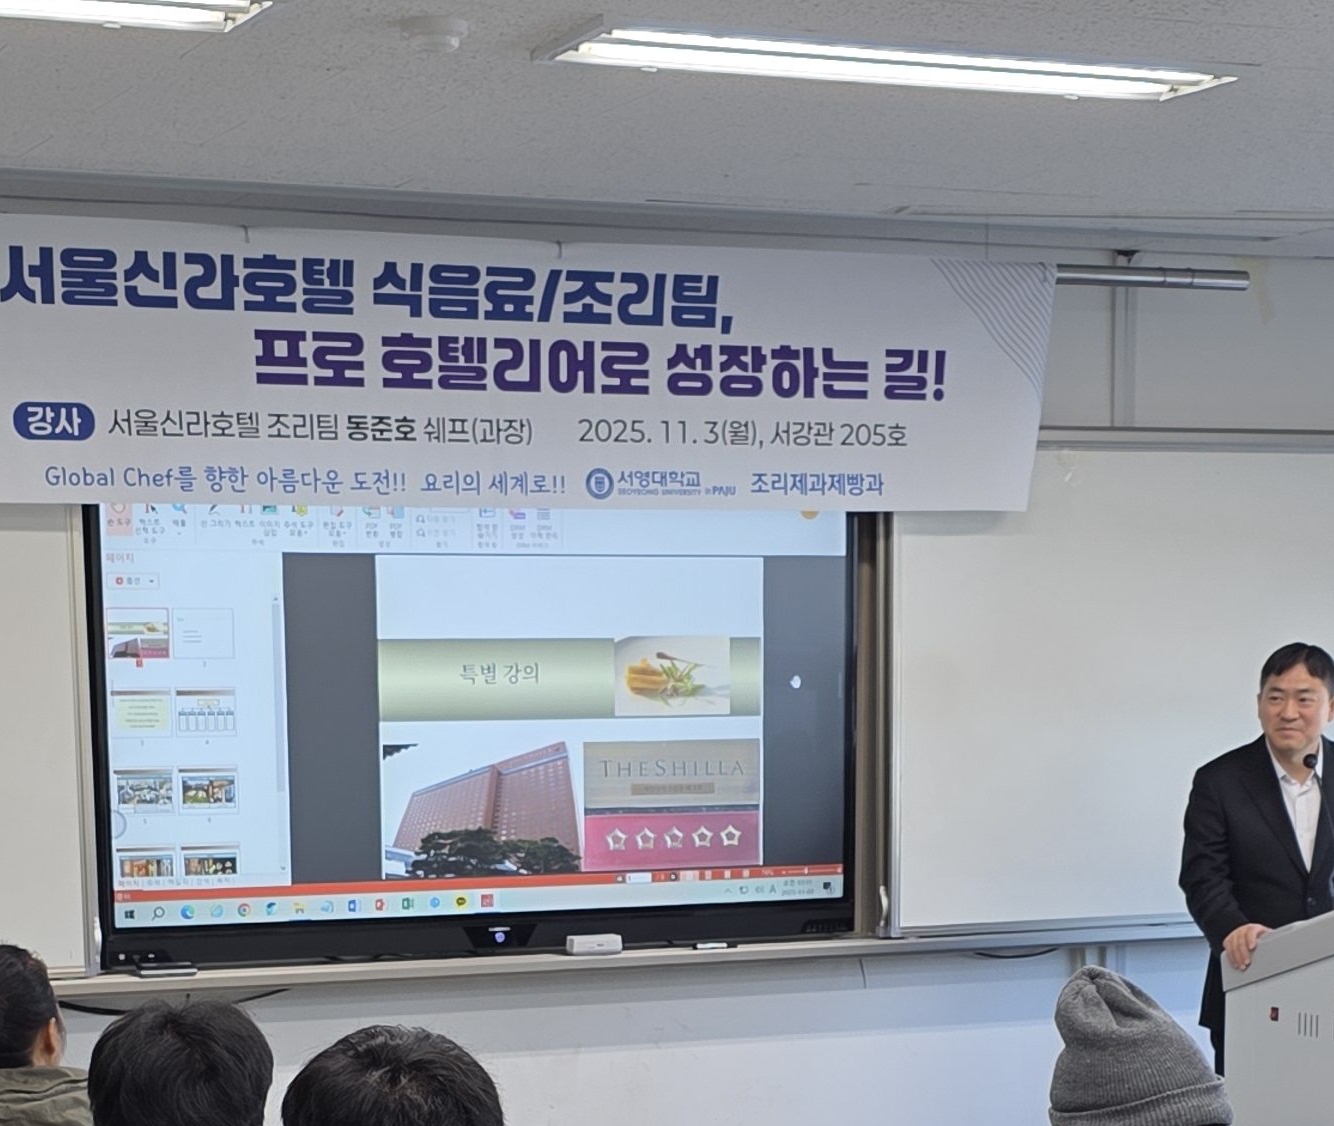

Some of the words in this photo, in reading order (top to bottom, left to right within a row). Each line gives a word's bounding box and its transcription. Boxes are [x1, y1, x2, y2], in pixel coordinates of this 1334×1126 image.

[0, 244, 355, 316] 서울신라호텔
[372, 260, 734, 335] 식음료/조리팀,
[253, 328, 365, 388] 프로
[380, 332, 650, 396] 호텔리어로
[666, 343, 869, 400] 성장하는
[883, 348, 947, 402] 길!
[26, 406, 82, 436] 강사
[108, 408, 261, 439] 서울신라호텔
[267, 413, 340, 442] 조리팀
[346, 414, 417, 442] 동준호
[423, 416, 533, 446] 쉐프(과장)
[769, 420, 836, 447] 서강관
[839, 422, 908, 447] 205호
[44, 465, 115, 488] Global
[123, 465, 198, 492] Chef를
[203, 466, 249, 493] 향한
[256, 467, 344, 494] 아름다운
[349, 469, 408, 496] 도전!!
[420, 469, 481, 496] 요리의
[488, 470, 566, 497] 세계로!!
[617, 470, 702, 488] 서영대학교
[750, 471, 885, 497] 조리제과제빵과
[459, 661, 497, 686] 특별
[502, 661, 540, 686] 강의
